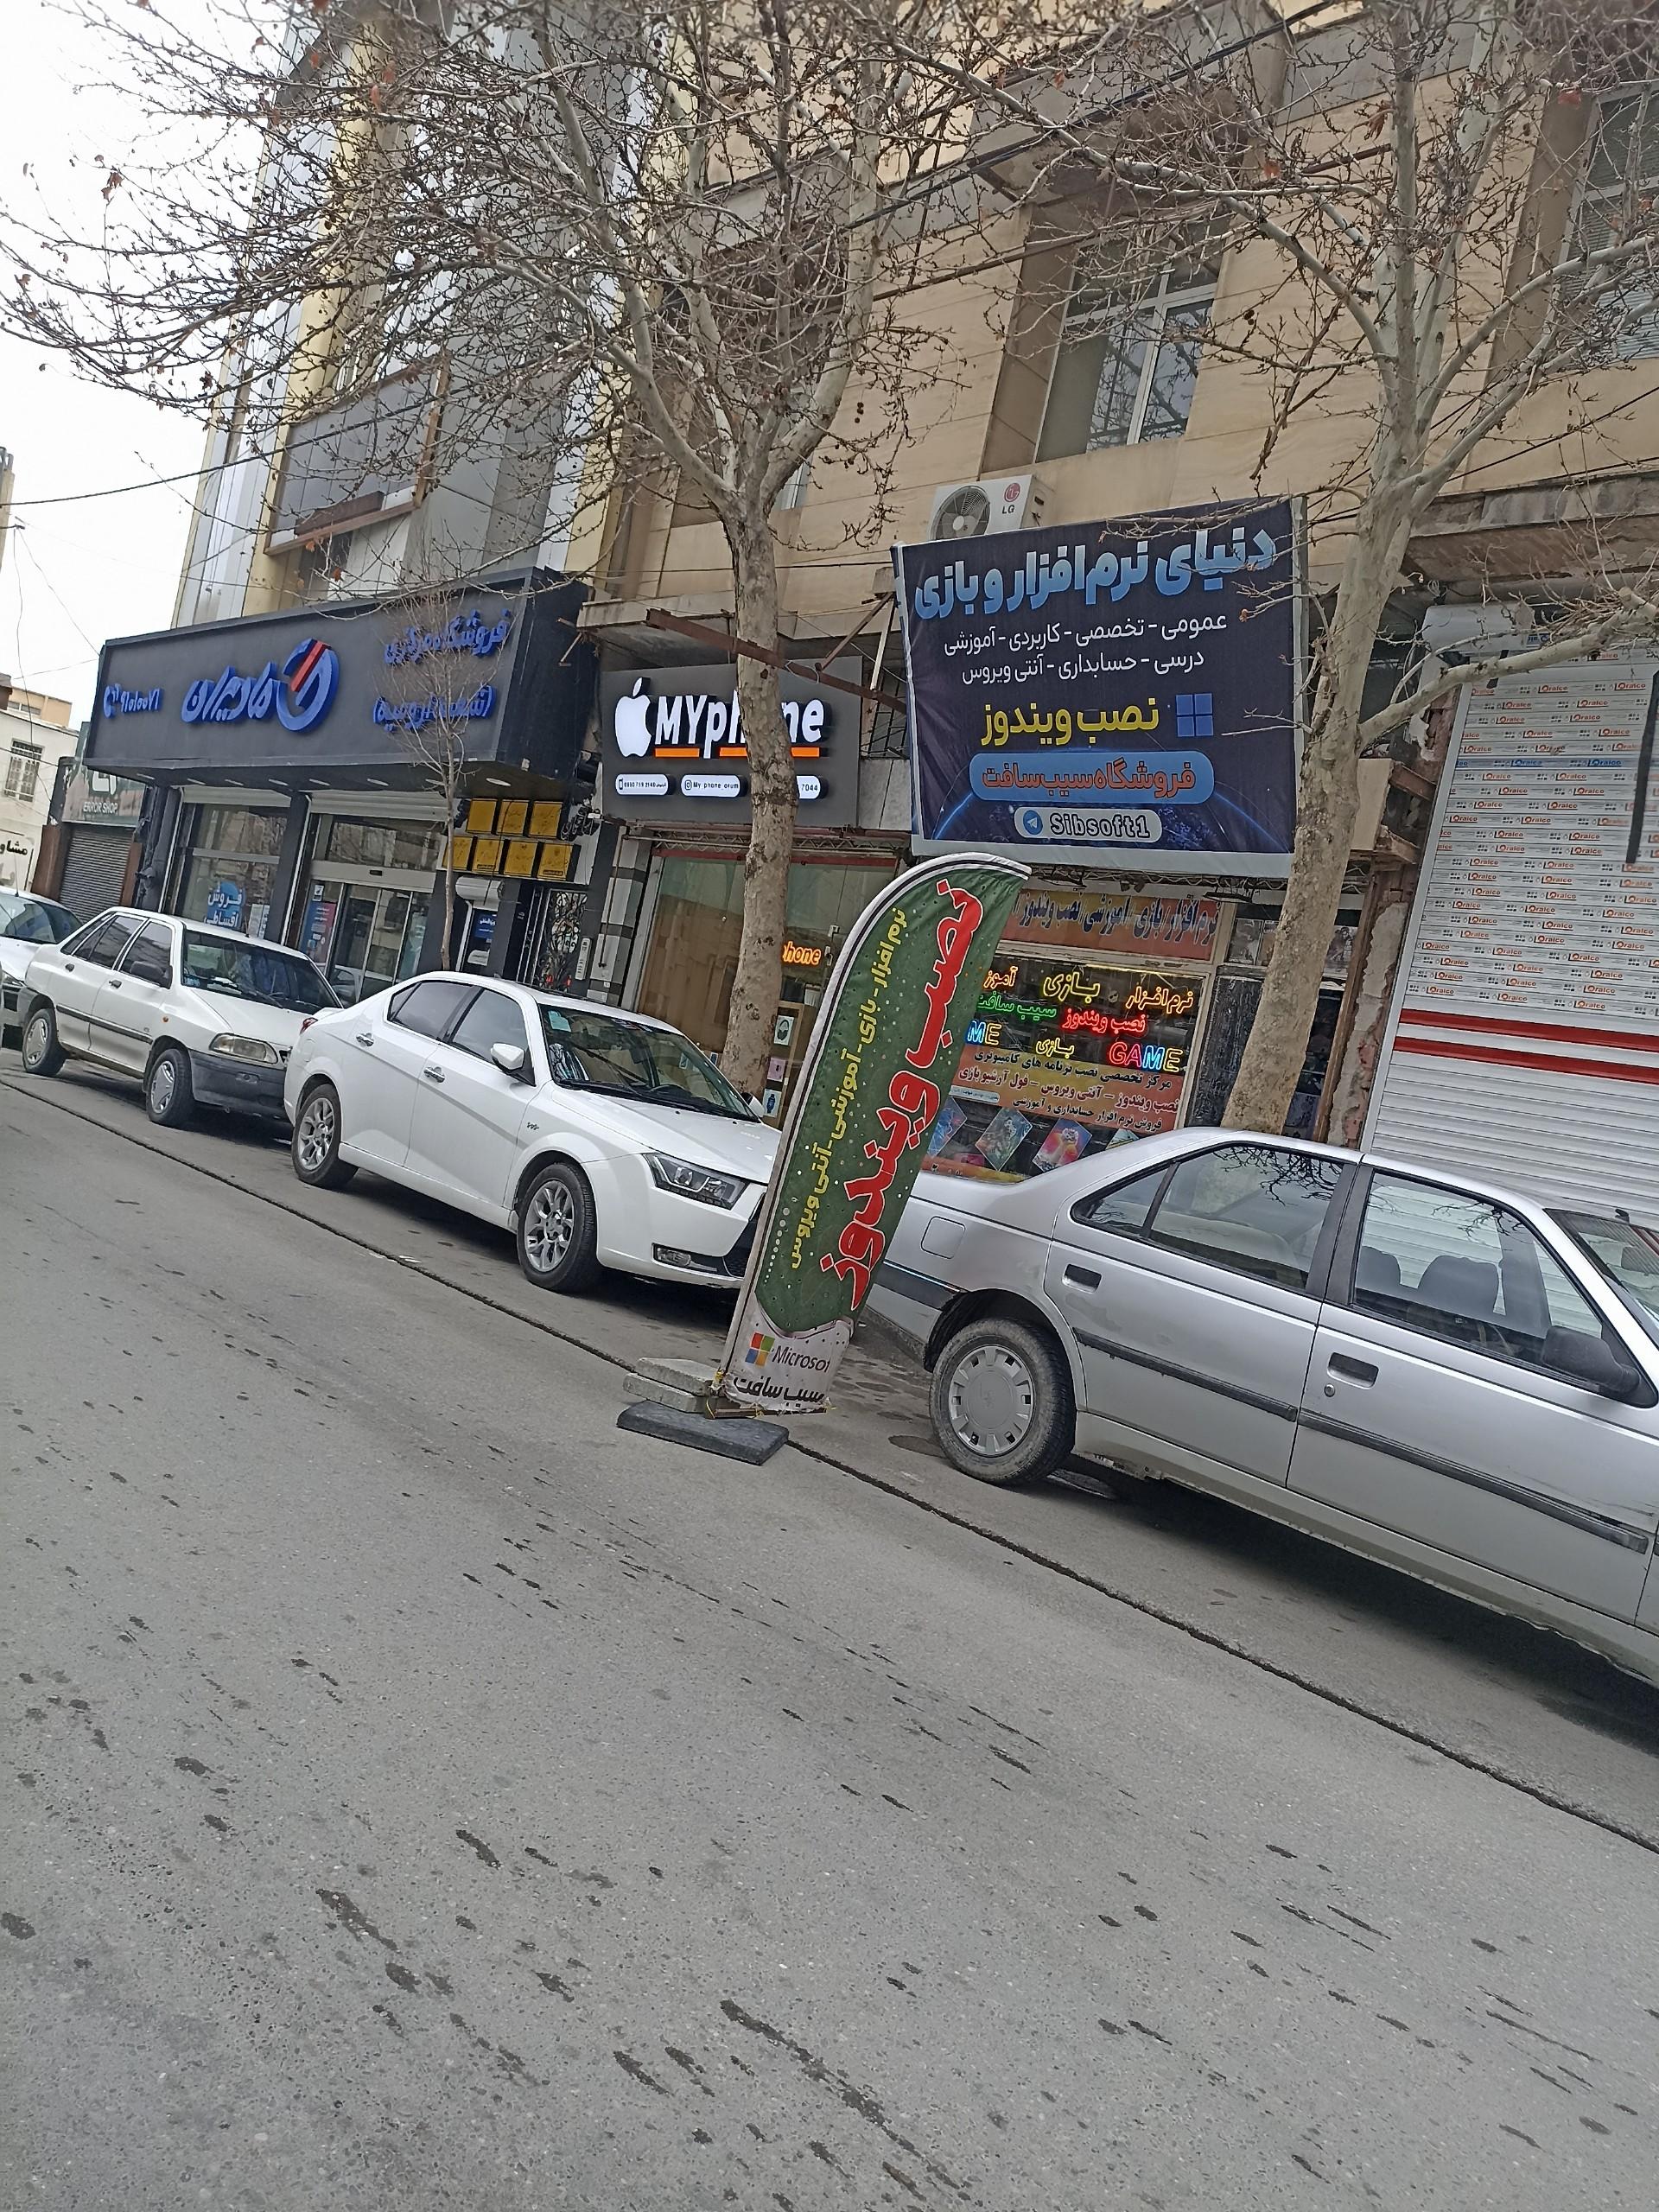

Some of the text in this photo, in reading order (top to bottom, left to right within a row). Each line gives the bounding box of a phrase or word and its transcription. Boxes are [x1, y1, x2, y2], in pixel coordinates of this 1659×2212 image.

[1001, 505, 1015, 515] LG
[914, 525, 1276, 620] دنیای نرم افزار و بازی
[944, 613, 1227, 657] عمومی تخصصی کاربردی آموزشی
[962, 651, 1205, 685] درسی حسابداری آنتی ویروس
[981, 696, 1160, 746] نصب ویندوز
[982, 757, 1196, 798] فروشگاه سیب سافت
[82, 801, 119, 814] ERROR SHOP
[1049, 812, 1150, 838] Sibsoft1
[207, 880, 243, 909] فروش
[905, 878, 984, 1069] نصب
[1043, 971, 1101, 1004] بازی
[1125, 986, 1194, 1014] نرم افزار
[1016, 1003, 1058, 1021] سیب
[1062, 1007, 1147, 1034] نصب ویندوز
[1035, 1037, 1075, 1059] بازی
[1108, 1040, 1184, 1073] GAME
[1021, 1056, 1042, 1070] های
[1044, 1059, 1073, 1077] برنامه
[1074, 1065, 1098, 1077] نصب
[959, 1066, 981, 1083] بازی
[1009, 1075, 1028, 1090] فول
[1100, 1071, 1142, 1084] تخصصی
[1145, 1073, 1172, 1090] مرکز
[791, 907, 908, 1269] نرم افزار بازی آموزشی آنتی ویروس
[1040, 1081, 1075, 1099] ویروس
[1077, 1086, 1103, 1101] آنتی
[1013, 1098, 1046, 1109] آموزشی
[1116, 1092, 1151, 1112] ویندوز
[1152, 1100, 1180, 1115] نصب
[1052, 1104, 1095, 1119] حسابداری
[1096, 1109, 1117, 1122] افزار
[1117, 1114, 1135, 1128] نرم
[1135, 1117, 1163, 1133] فروش
[820, 1070, 941, 1312] ویندوز
[733, 1375, 825, 1408] سیب سافت
